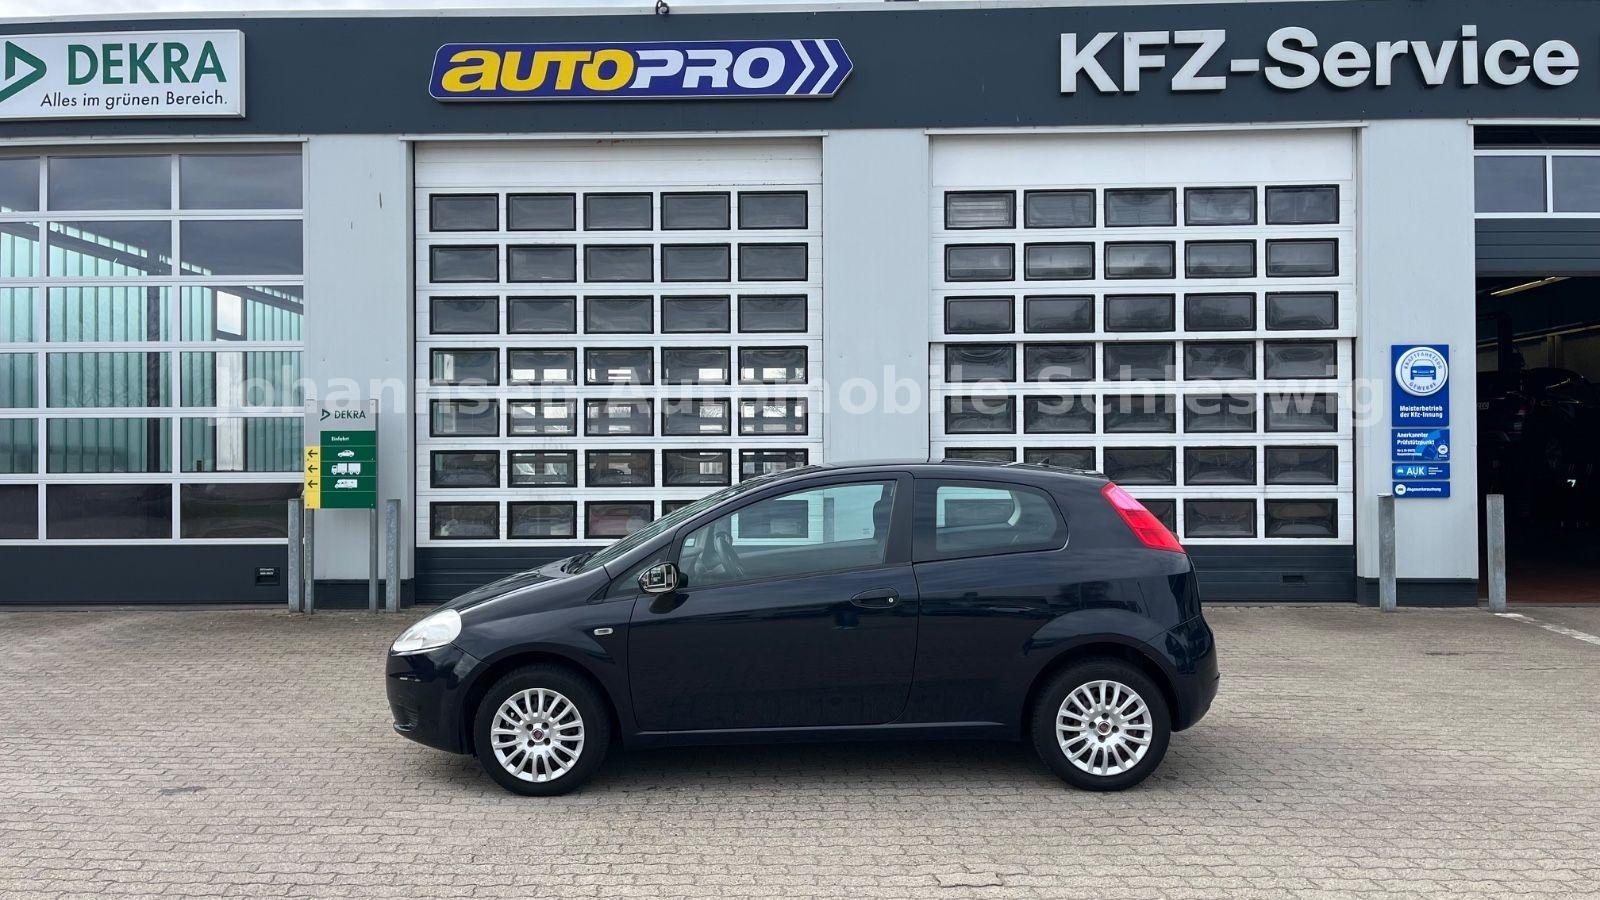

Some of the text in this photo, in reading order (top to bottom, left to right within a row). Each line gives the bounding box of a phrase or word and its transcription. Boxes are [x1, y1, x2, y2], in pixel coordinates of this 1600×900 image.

[67, 40, 228, 85] DEKRA
[1060, 24, 1580, 93] KFZ-Service
[40, 89, 228, 110] Alles im grünen Bereich.
[334, 409, 367, 419] DEKRA
[1410, 411, 1443, 419] Kfz-Innung
[1406, 466, 1425, 475] AUK
